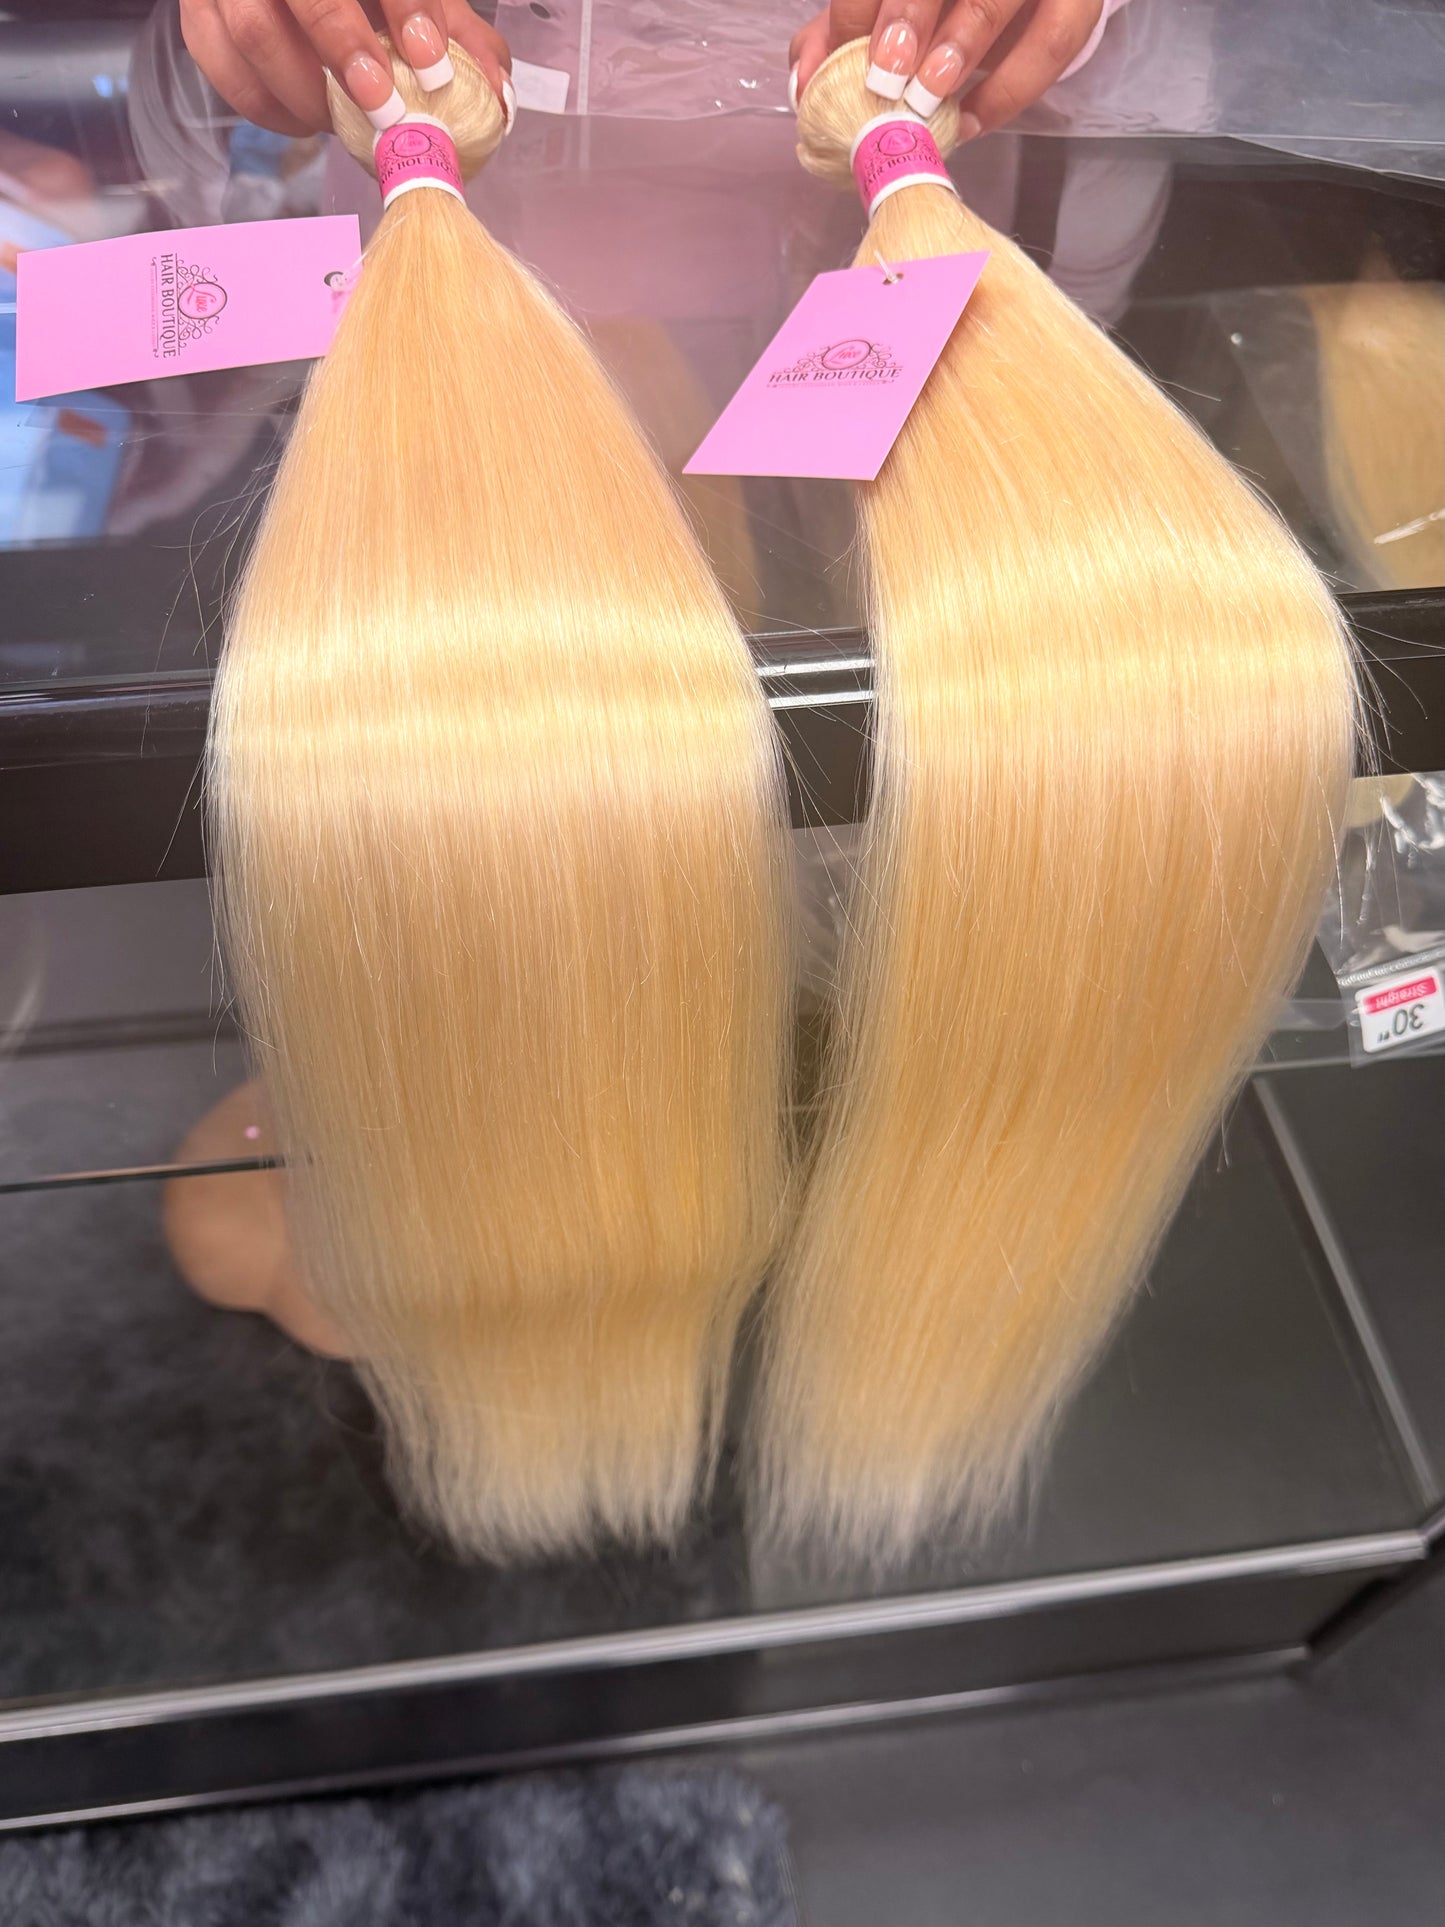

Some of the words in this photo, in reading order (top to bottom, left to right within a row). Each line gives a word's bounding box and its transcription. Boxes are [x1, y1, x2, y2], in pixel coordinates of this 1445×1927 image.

[160, 253, 175, 286] HAIR
[187, 282, 217, 313] Luxe
[160, 288, 177, 358] BOUTIQUE
[768, 371, 809, 383] HAIR
[812, 368, 903, 381] BOUTIQUE
[1375, 983, 1427, 1009] Straight
[1377, 1003, 1425, 1043] 30"
